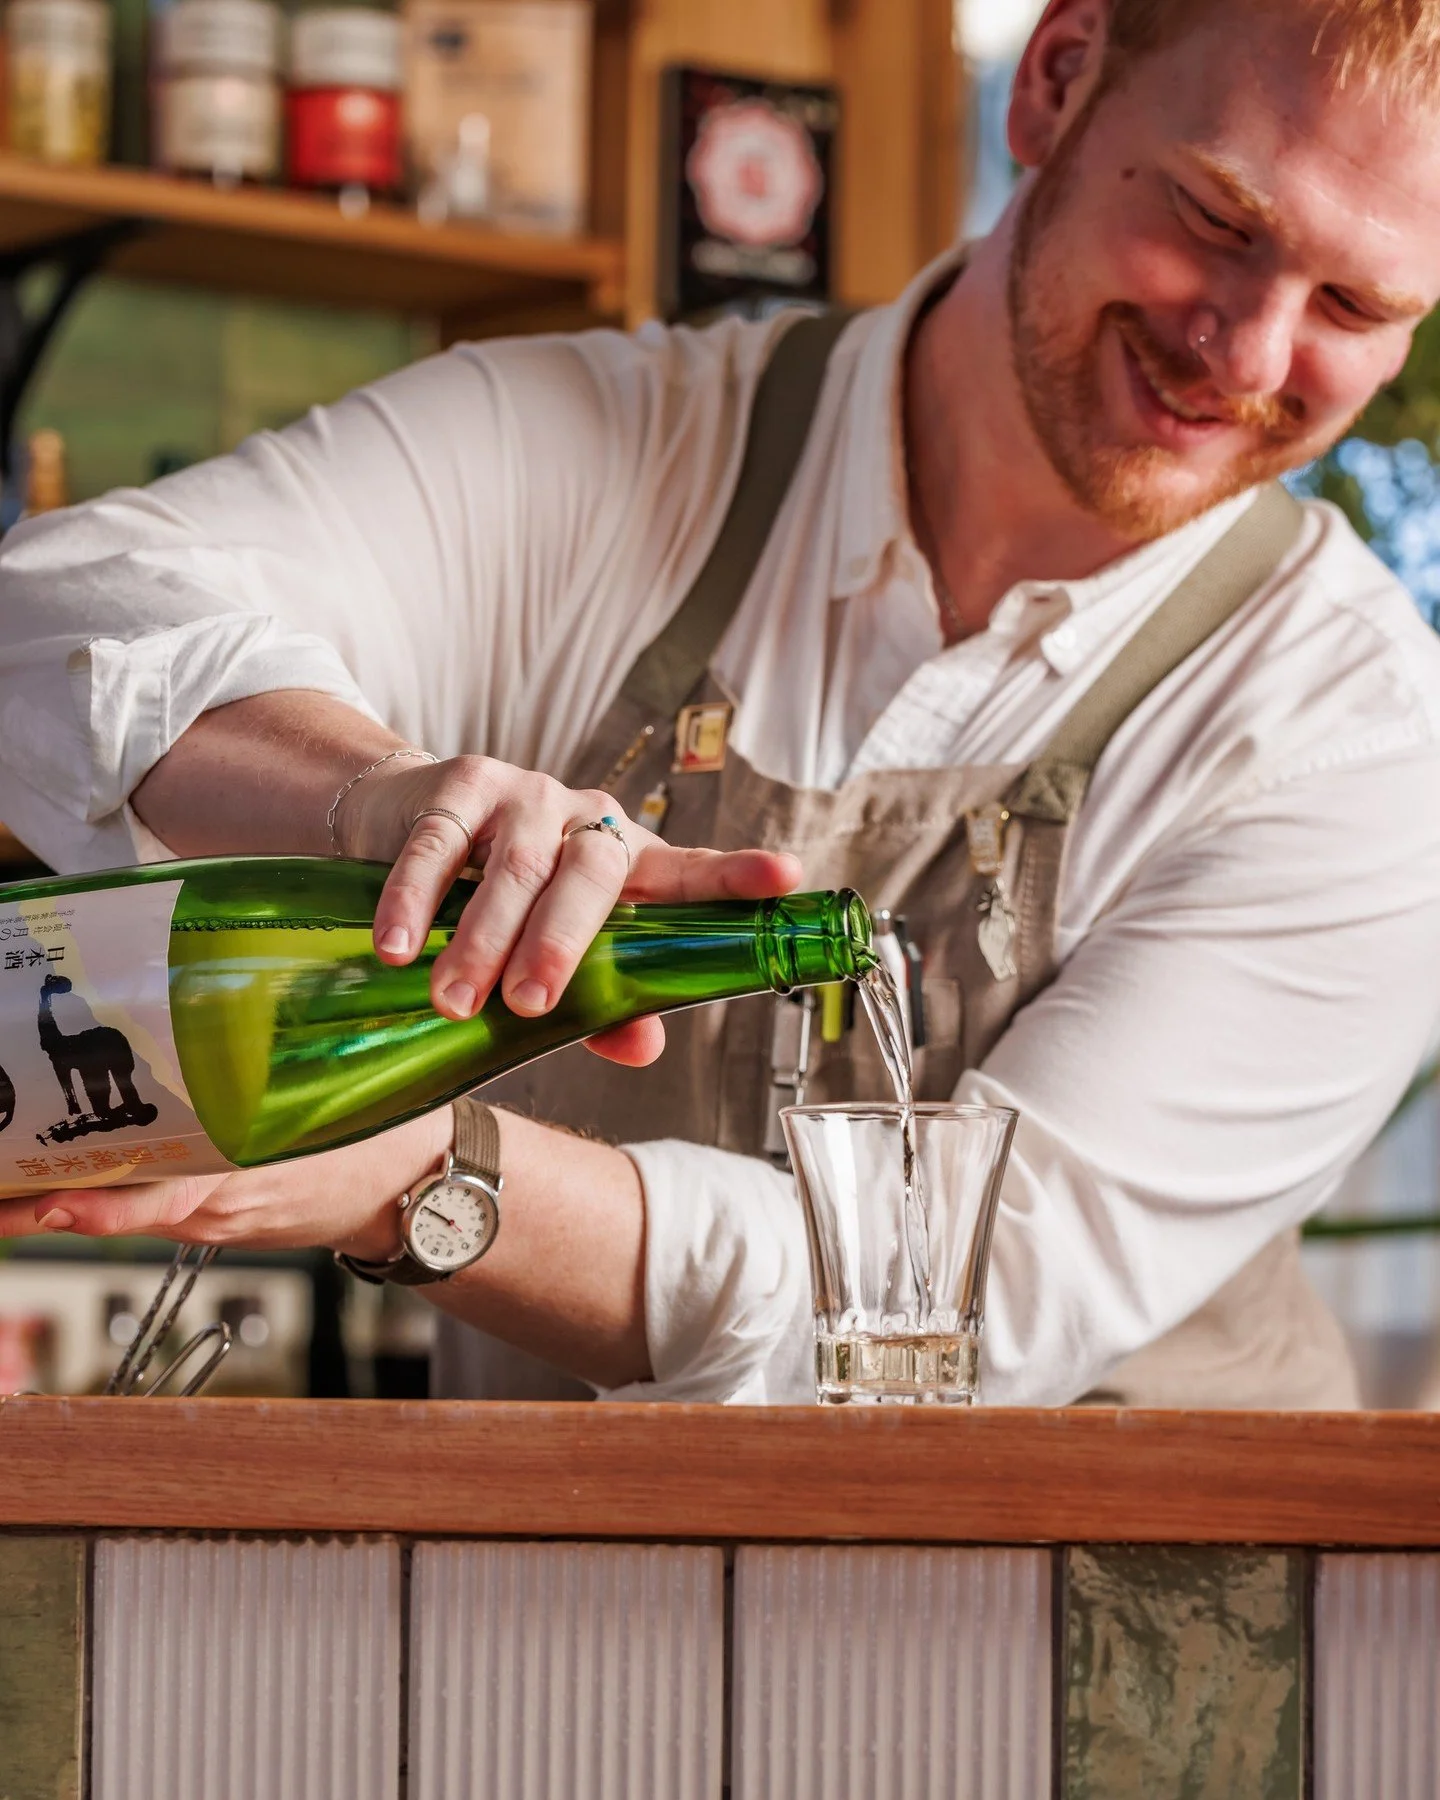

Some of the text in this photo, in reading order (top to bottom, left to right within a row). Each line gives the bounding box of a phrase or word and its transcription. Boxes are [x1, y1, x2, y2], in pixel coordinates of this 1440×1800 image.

[4, 946, 66, 970] 日本酒
[0, 973, 159, 1147] 月
[16, 1142, 193, 1178] 特別純米酒
[446, 1186, 454, 1196] 5
[463, 1188, 472, 1197] 6
[415, 1222, 423, 1232] 2
[474, 1228, 483, 1238] 9
